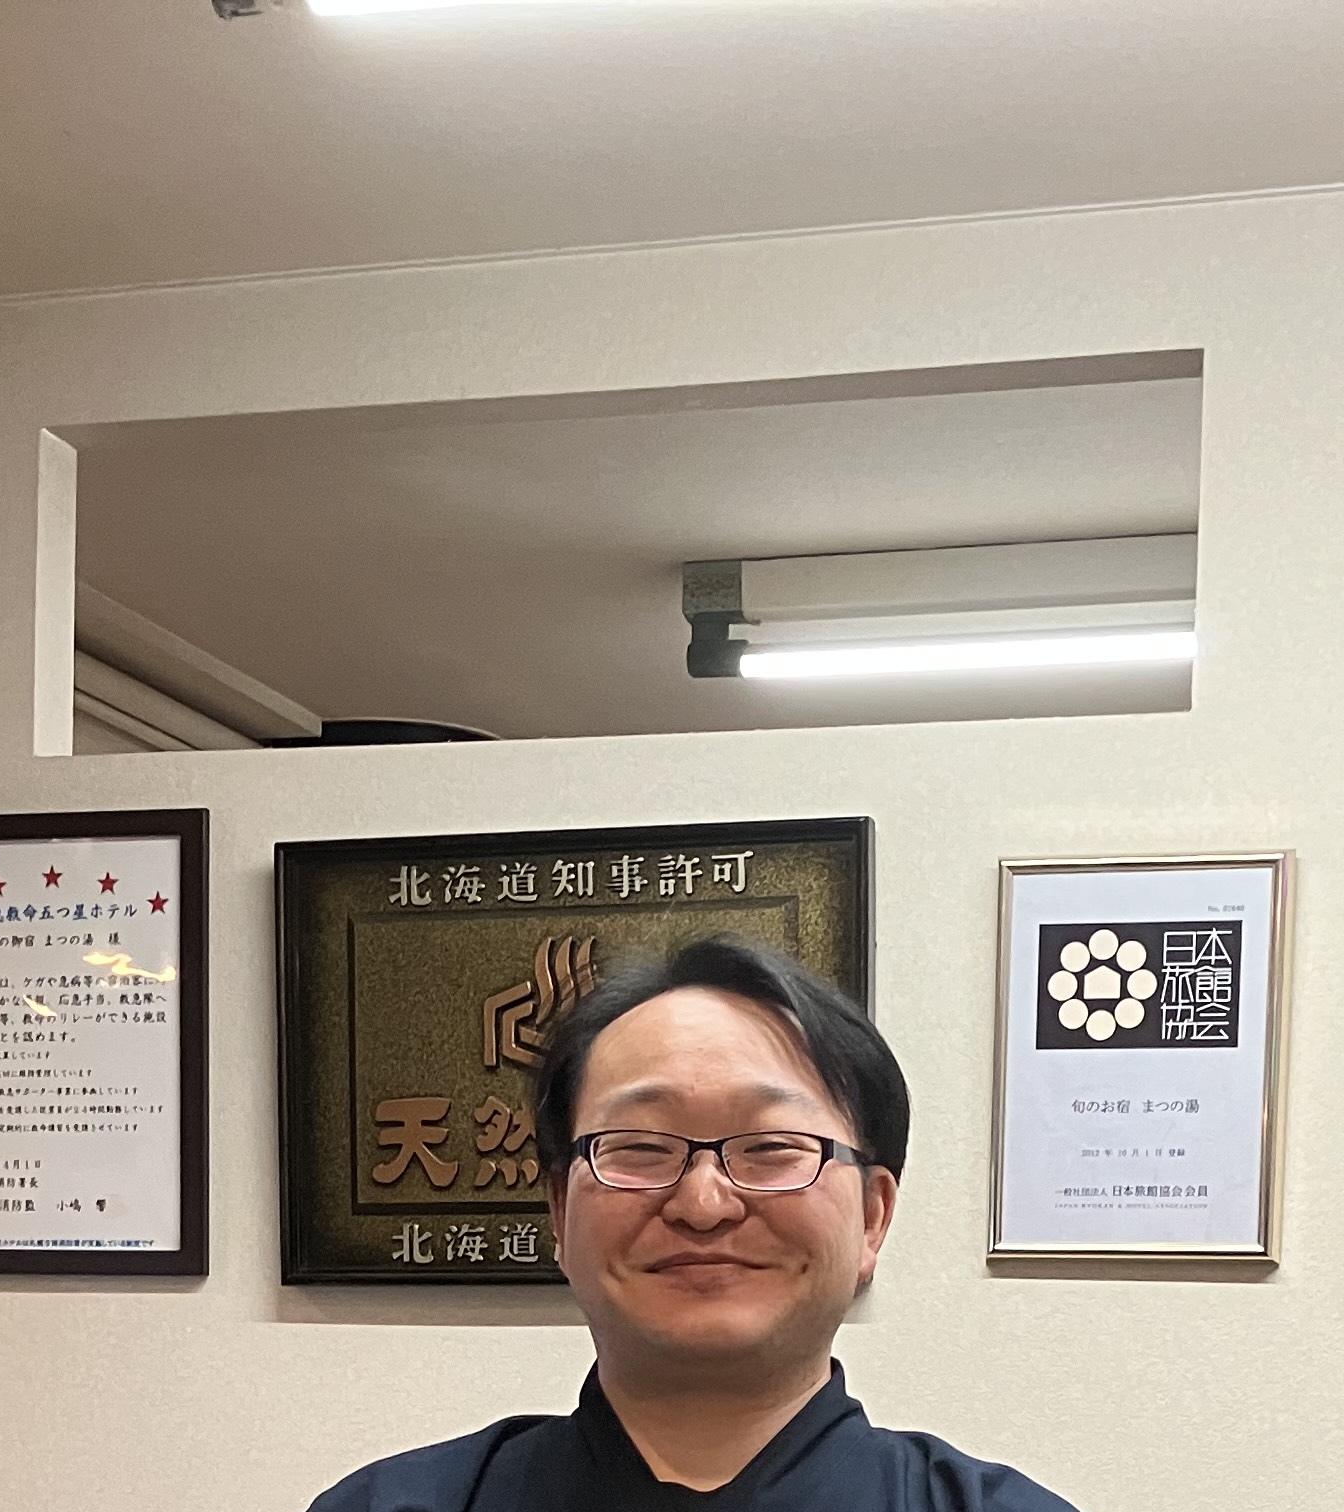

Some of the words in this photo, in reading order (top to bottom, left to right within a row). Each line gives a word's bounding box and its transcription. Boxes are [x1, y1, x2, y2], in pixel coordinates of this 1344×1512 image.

[388, 849, 756, 907] 北海道知事許可
[1071, 1099, 1131, 1114] 旬のお宿
[1142, 1098, 1200, 1114] まつの湯
[391, 1222, 563, 1265] 北海道
